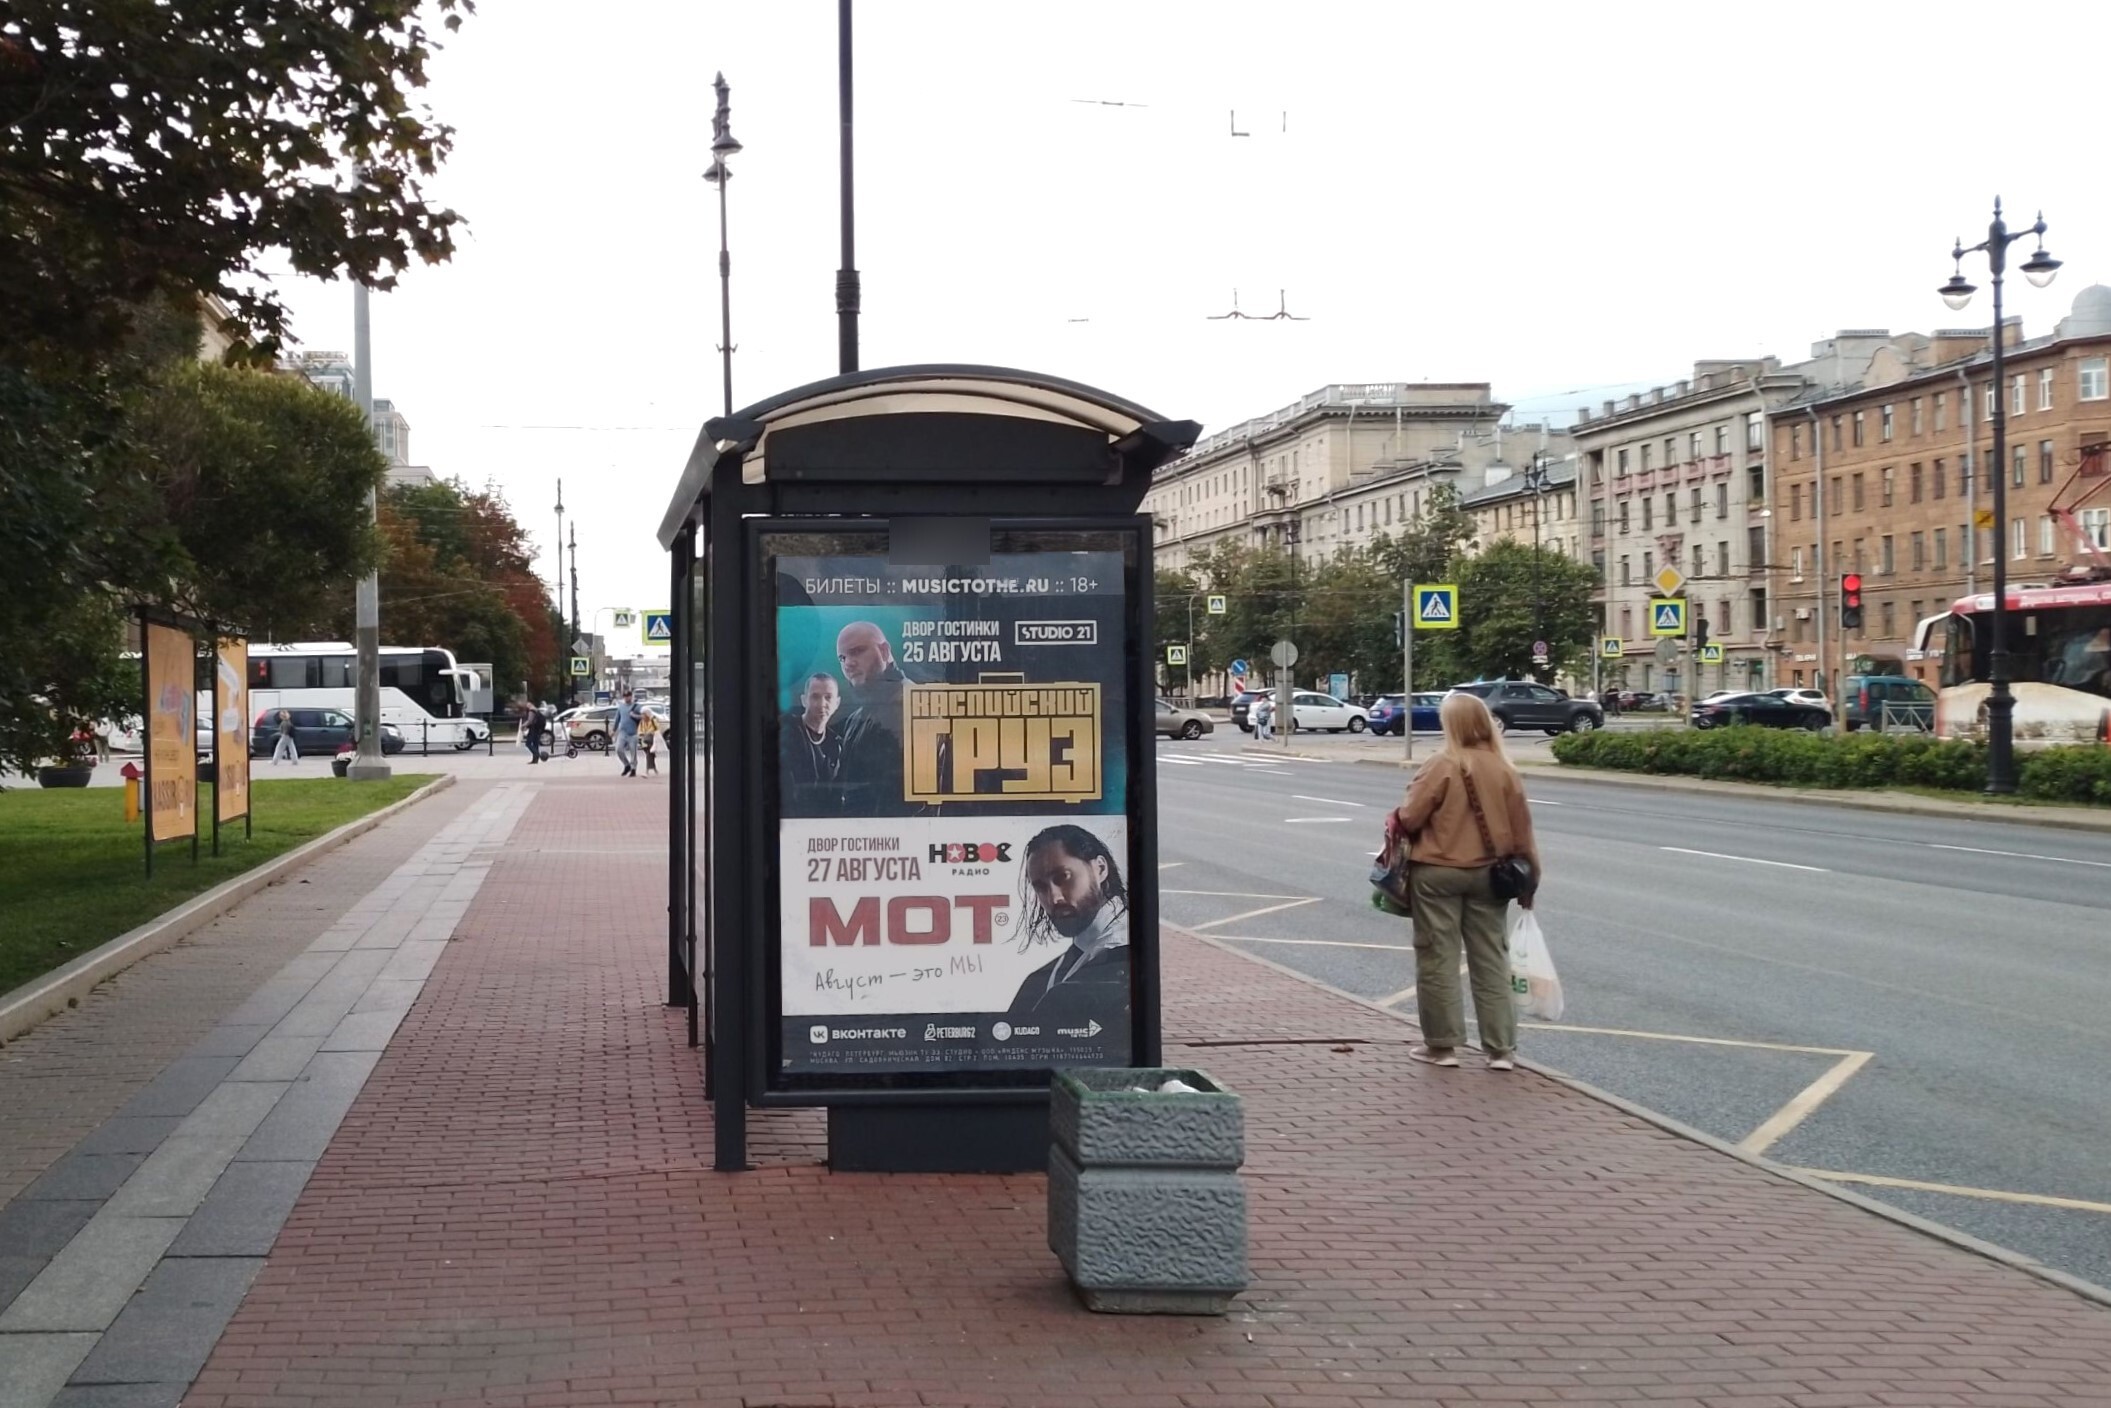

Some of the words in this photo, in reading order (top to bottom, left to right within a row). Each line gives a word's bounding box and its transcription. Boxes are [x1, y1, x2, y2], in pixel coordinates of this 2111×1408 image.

[805, 578, 881, 594] БИЛЕТЫ
[903, 579, 1049, 594] MUSICTOTHE.RU
[1070, 578, 1099, 592] 18+
[903, 621, 935, 638] ДВОР
[938, 621, 999, 636] ГОСТИНКИ
[1021, 626, 1074, 639] STUDIO
[1076, 625, 1091, 639] 21
[903, 642, 924, 663] 25
[929, 640, 1001, 662] АВГУСТА
[912, 688, 1093, 717] КАСПИЙСКИЙ
[913, 718, 1093, 793] ГРУЗ
[808, 837, 838, 853] ДВОР
[840, 837, 900, 852] ГОСТИНКИ
[808, 859, 830, 882] 27
[836, 856, 921, 882] АВГУСТА
[952, 868, 989, 876] РАДИО
[809, 895, 1010, 947] МОТ
[815, 968, 882, 1000] Август
[912, 967, 942, 982] это
[832, 1028, 906, 1039] вконтакте
